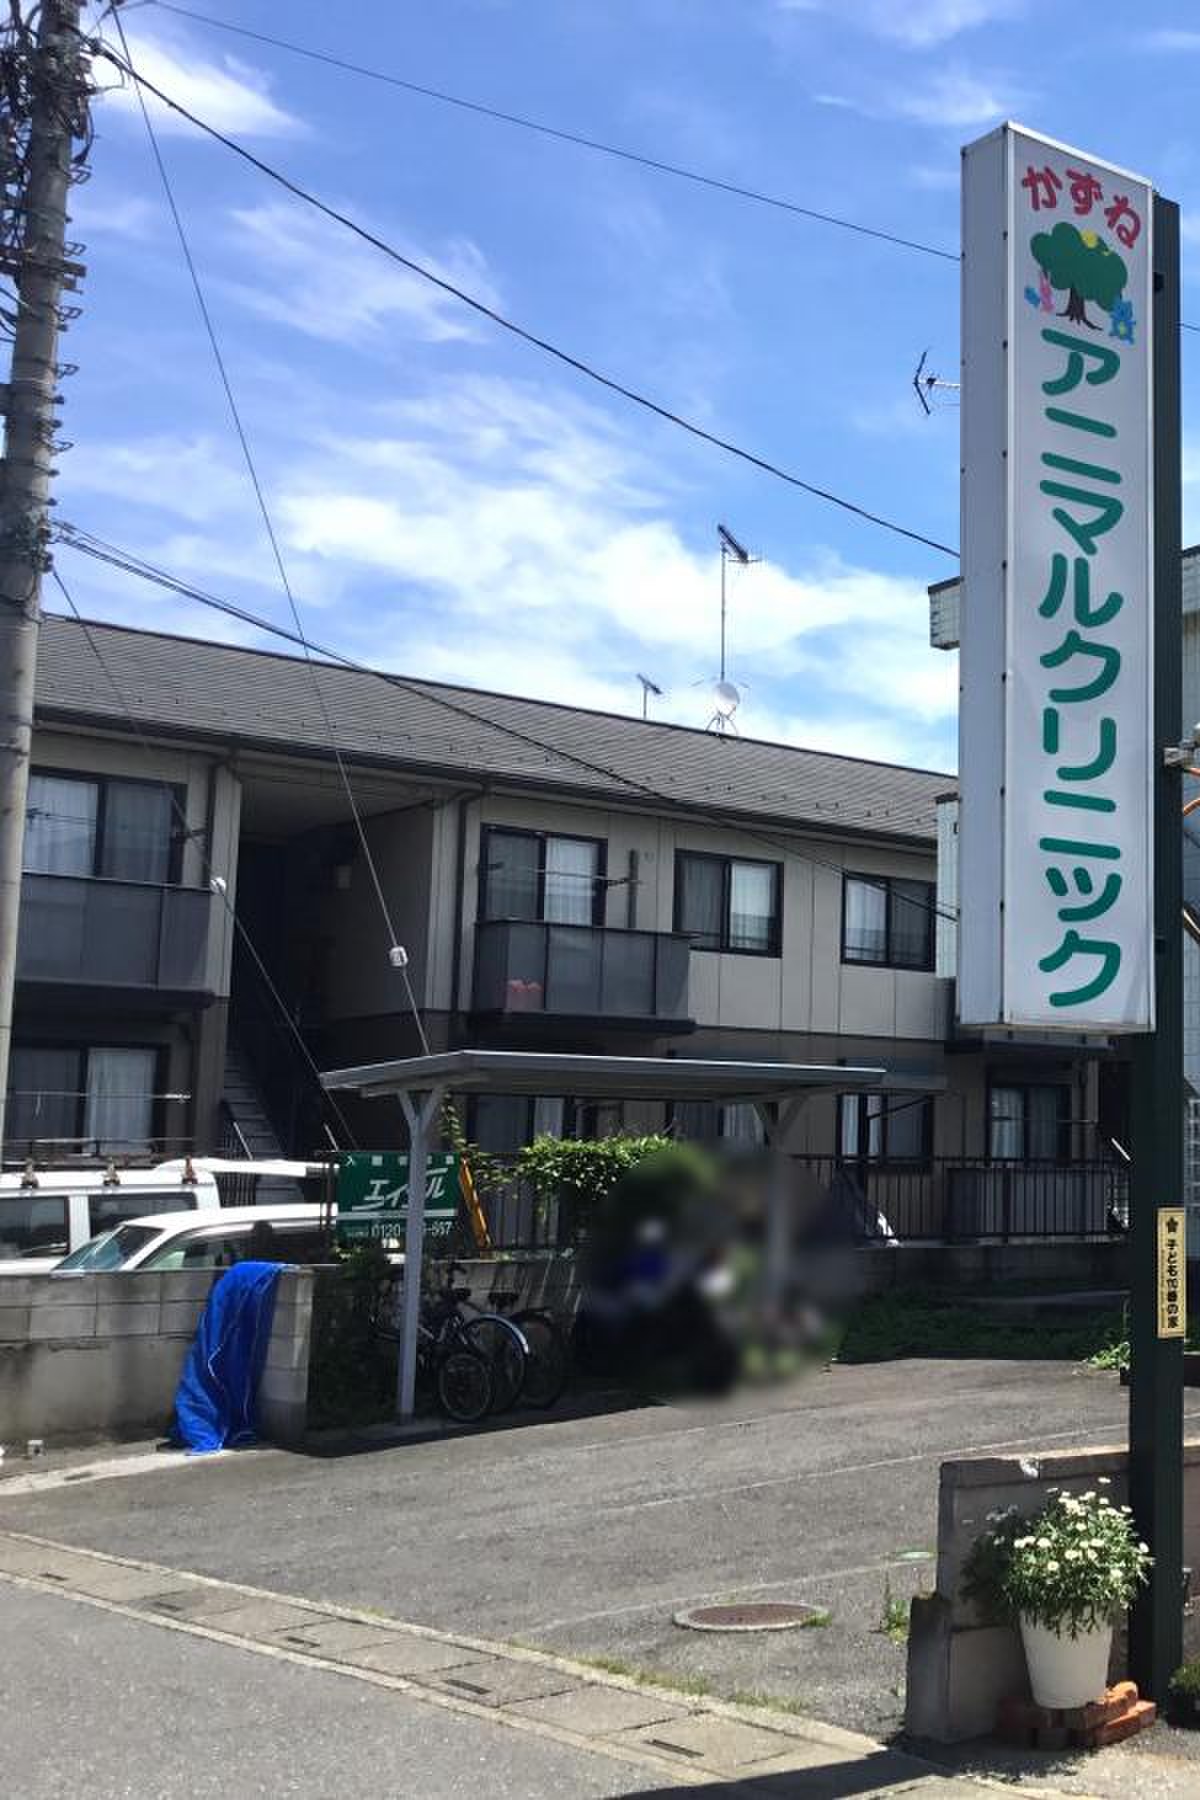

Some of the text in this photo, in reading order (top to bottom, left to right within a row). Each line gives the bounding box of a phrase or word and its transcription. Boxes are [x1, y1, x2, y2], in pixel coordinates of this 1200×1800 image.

[1021, 165, 1142, 249] かずね
[1038, 327, 1124, 1008] アニマルクリニック
